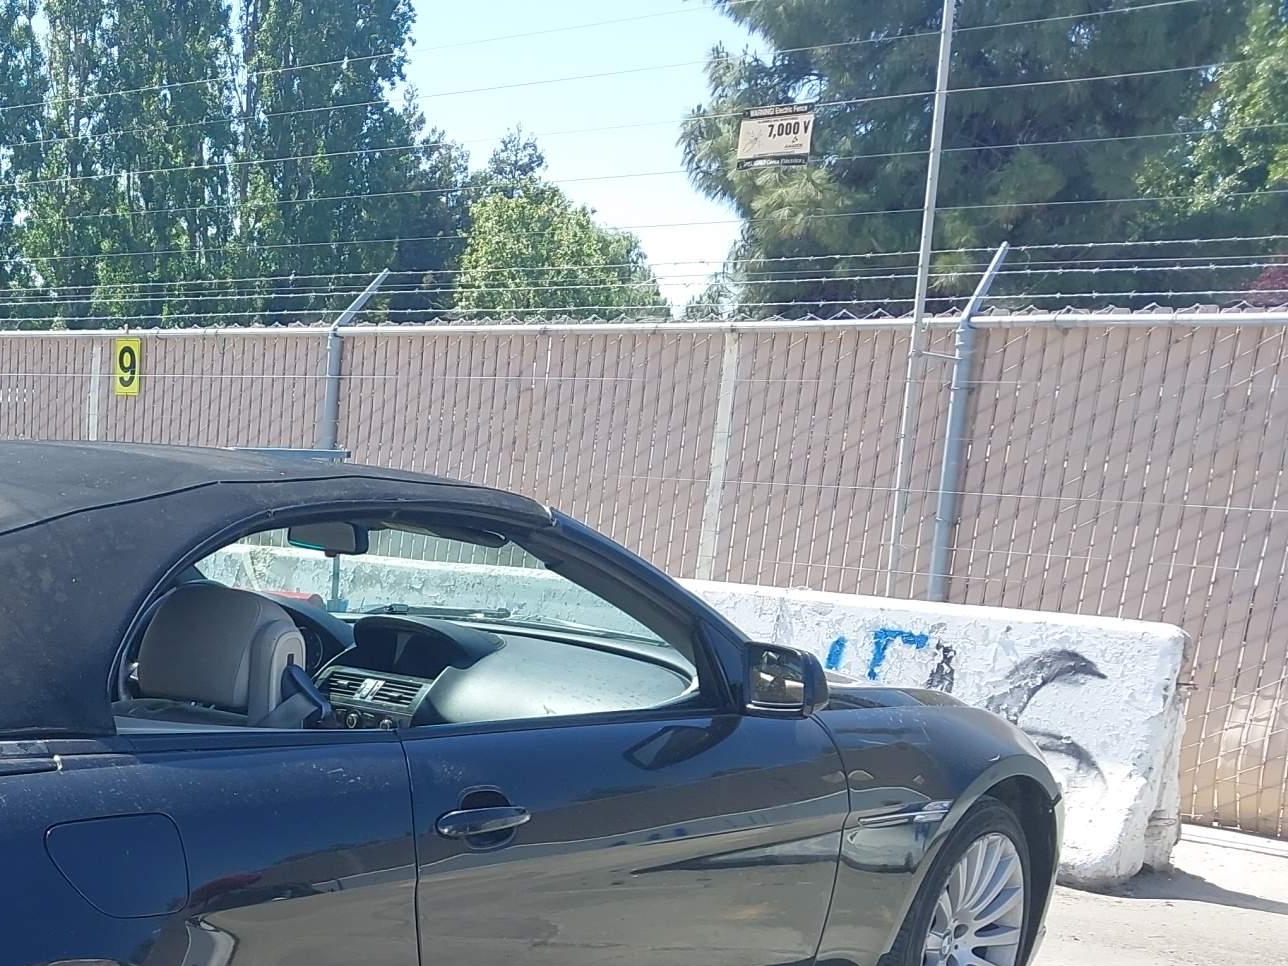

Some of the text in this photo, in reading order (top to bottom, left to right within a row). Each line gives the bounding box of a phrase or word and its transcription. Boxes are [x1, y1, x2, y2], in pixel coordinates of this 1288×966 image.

[768, 121, 800, 139] 7,000
[803, 119, 810, 134] V
[118, 345, 136, 388] 9
